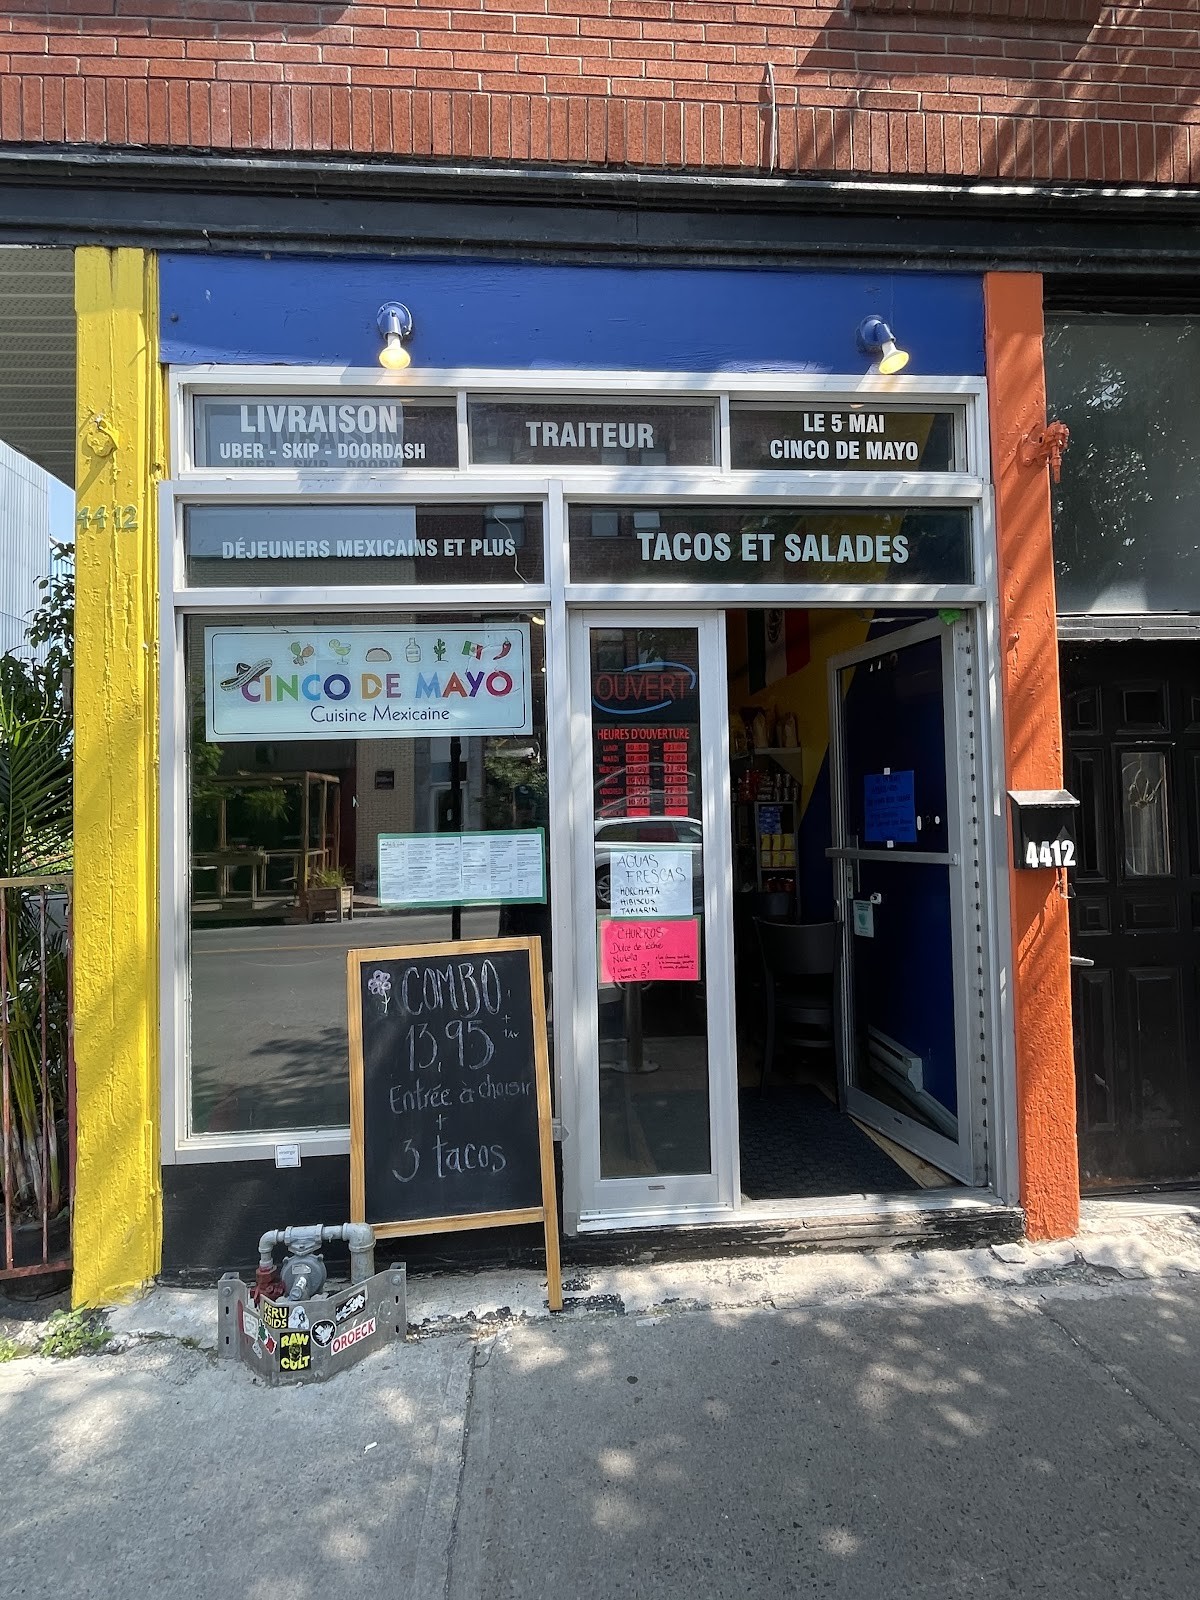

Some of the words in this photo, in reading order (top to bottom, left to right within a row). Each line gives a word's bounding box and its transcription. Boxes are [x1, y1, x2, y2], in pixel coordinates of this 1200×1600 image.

[240, 405, 397, 433] LIVRAISON
[803, 413, 825, 432] LE
[831, 413, 842, 433] 5
[849, 413, 885, 433] MAI
[526, 421, 654, 449] TRAITEUR
[220, 443, 264, 459] UBER
[282, 443, 319, 459] SKIP
[337, 443, 426, 459] DOORDASH
[770, 440, 830, 460] CINCO
[836, 440, 860, 460] DE
[866, 441, 919, 461] MAYO
[77, 505, 138, 530] 4412
[222, 537, 330, 559] DÉJEUNERS
[337, 539, 438, 558] MEXICAINS
[444, 539, 466, 557] ET
[471, 539, 516, 557] PLUS
[636, 532, 732, 562] TACOS
[742, 533, 775, 562] ET
[784, 533, 909, 563] SALADES
[241, 673, 351, 703] CINCO
[361, 672, 402, 700] DE
[415, 670, 513, 698] MAYO
[595, 673, 688, 701] OUVERT
[310, 705, 366, 723] Cuisine
[372, 704, 450, 722] Mexicaine
[598, 728, 629, 740] HEURES
[631, 728, 690, 740] D'OUVERTURE
[617, 854, 659, 868] AGUAS
[1026, 840, 1076, 868] 4412
[625, 867, 686, 883] FRESCAS
[620, 887, 660, 896] HORCHATA
[620, 898, 656, 906] HIBISCUS
[620, 907, 658, 915] TAMARIN
[618, 927, 663, 939] CHURROS
[634, 942, 642, 950] de
[402, 959, 501, 1018] COMBO
[389, 1078, 452, 1114] Entrée
[459, 1081, 475, 1104] à
[478, 1074, 533, 1099] choisir
[392, 1139, 420, 1182] 3
[433, 1134, 507, 1178] tacos
[264, 1301, 288, 1319] PERU
[281, 1332, 309, 1349] RAW
[332, 1322, 375, 1353] OROECK
[281, 1356, 310, 1371] CULT
